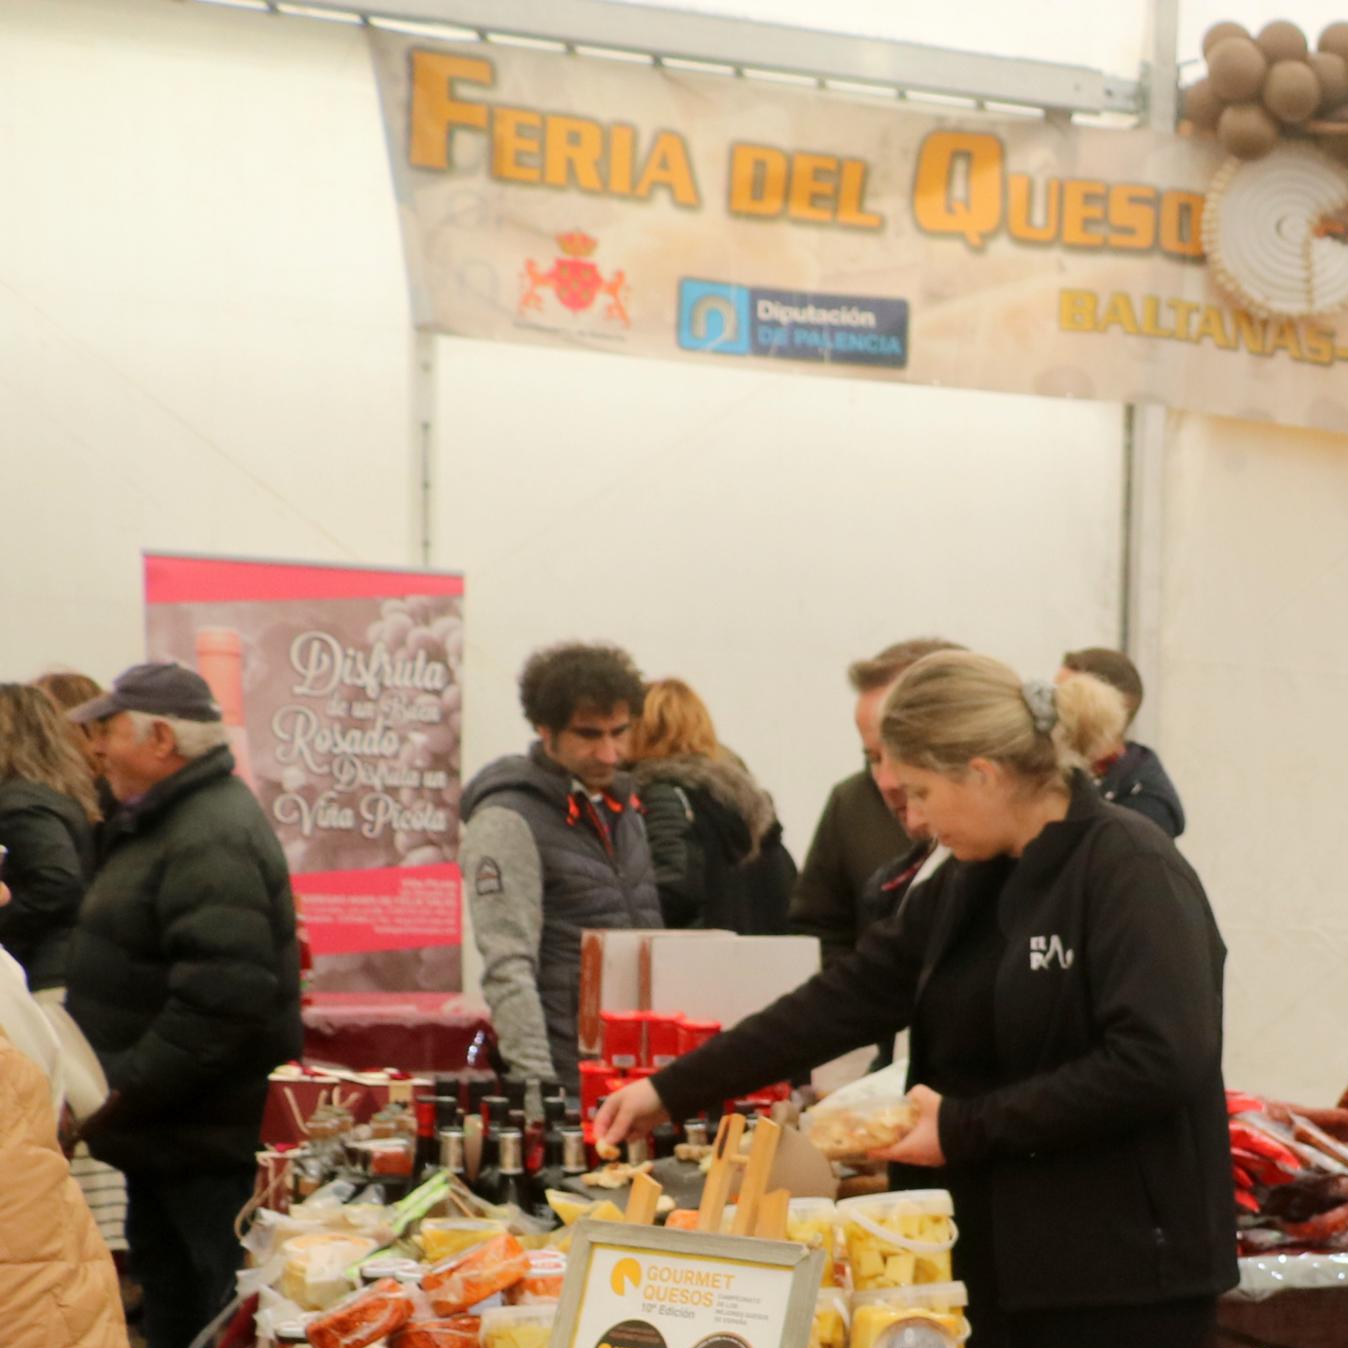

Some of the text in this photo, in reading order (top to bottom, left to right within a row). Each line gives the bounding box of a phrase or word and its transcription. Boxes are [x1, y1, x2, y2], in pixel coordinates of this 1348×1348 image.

[727, 142, 884, 229] DEL
[756, 299, 876, 328] Diputación
[757, 326, 902, 356] DE PALENCIA
[289, 630, 447, 700] Disfruta
[271, 703, 399, 775] Rosado
[273, 790, 448, 839] Viña Picota
[645, 1264, 735, 1290] GOURMET
[641, 1284, 714, 1309] QUESOS
[658, 1305, 695, 1320] Edición
